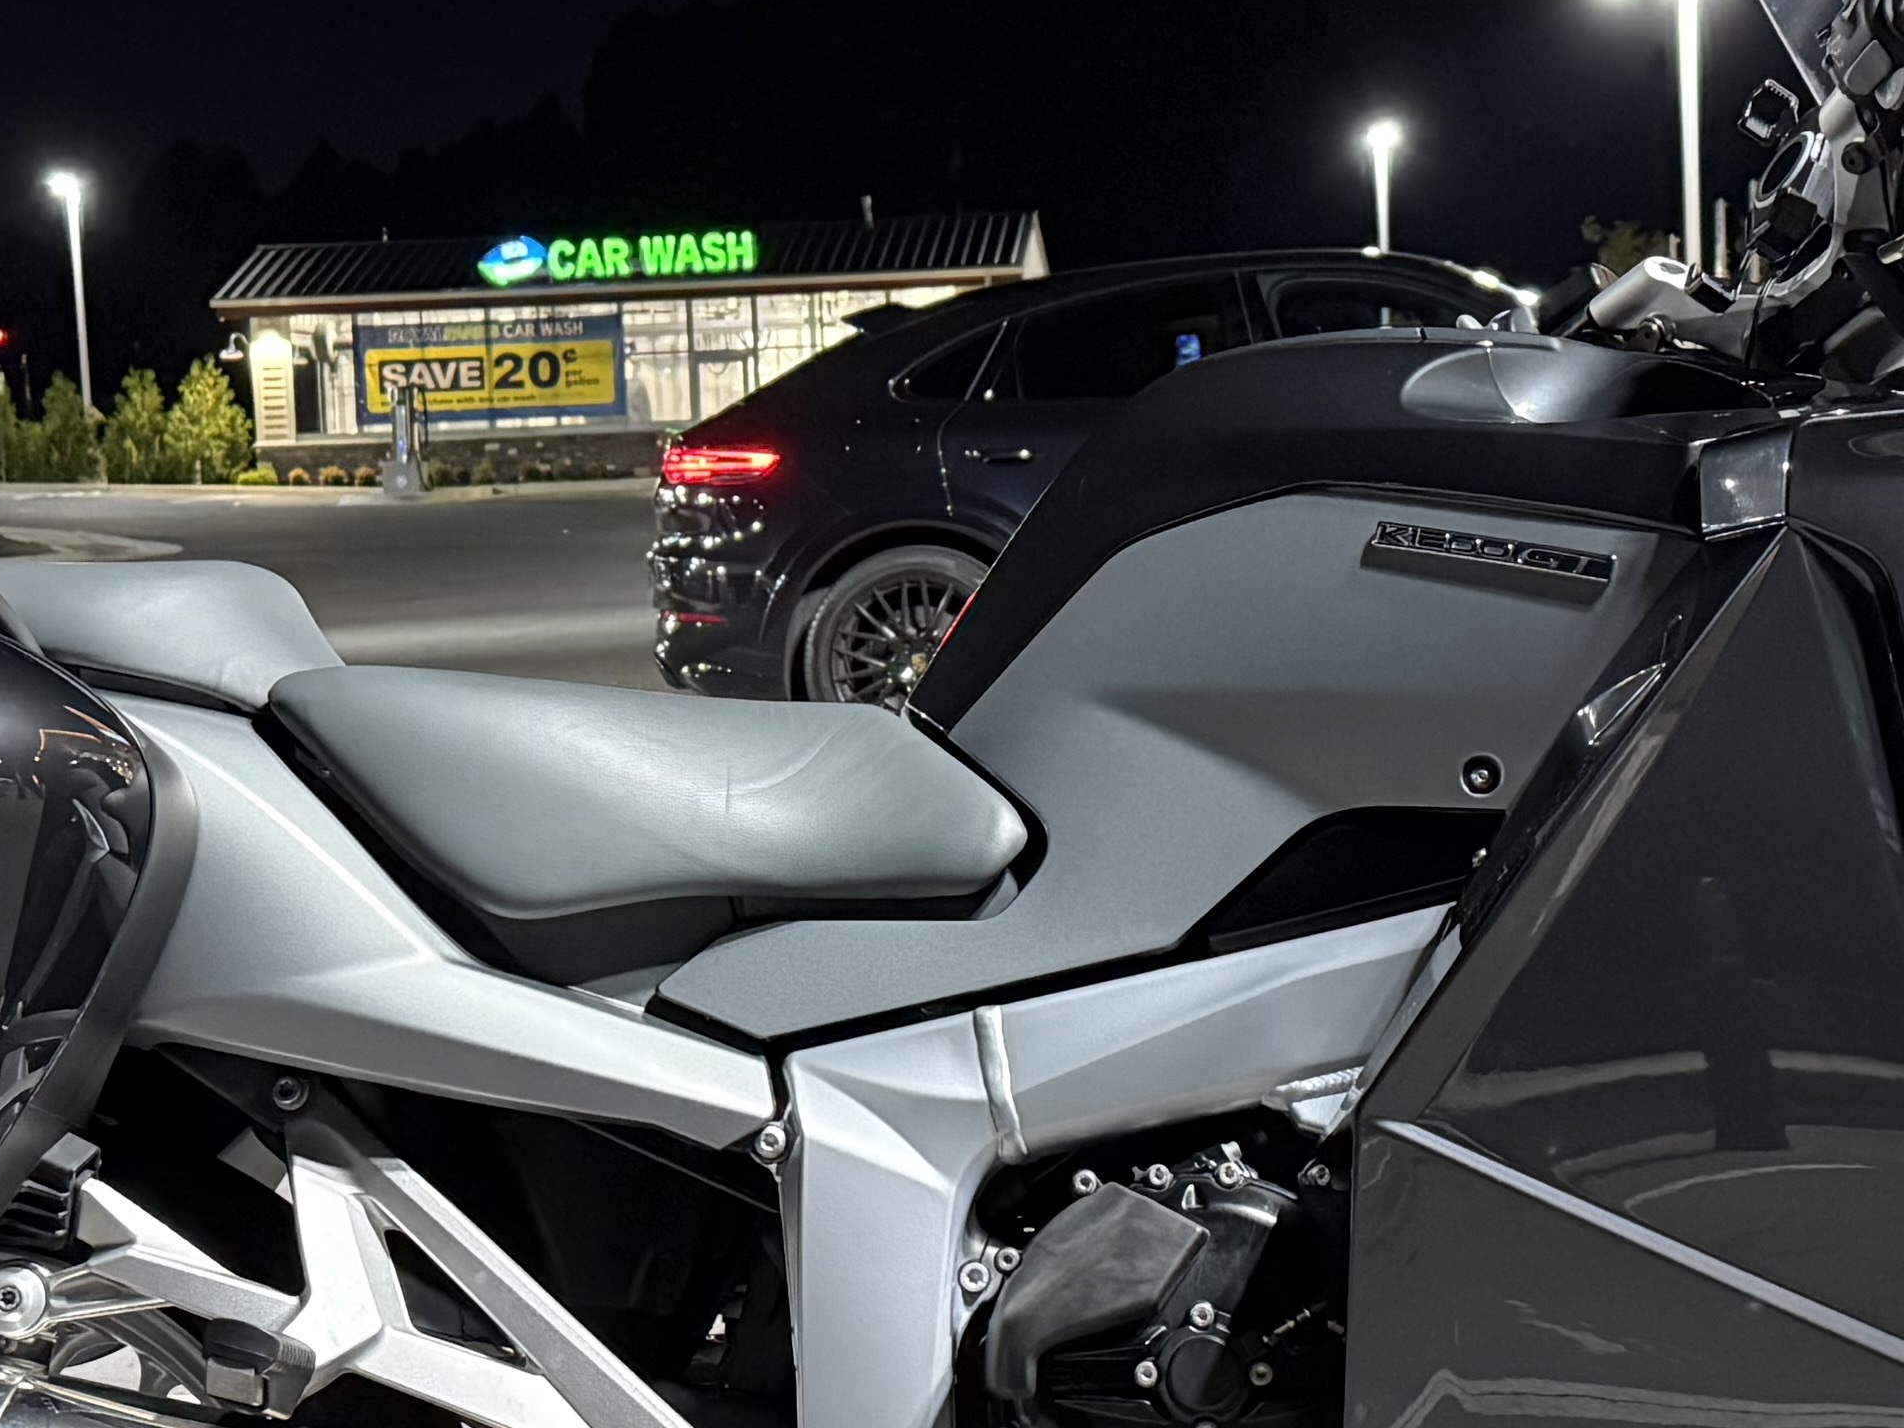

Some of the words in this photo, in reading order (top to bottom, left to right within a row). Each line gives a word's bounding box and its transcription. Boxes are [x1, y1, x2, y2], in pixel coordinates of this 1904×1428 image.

[547, 237, 631, 279] CAR
[639, 231, 755, 276] WASH
[503, 323, 535, 339] CAR
[540, 321, 584, 337] WASH
[381, 360, 482, 390] SAVE
